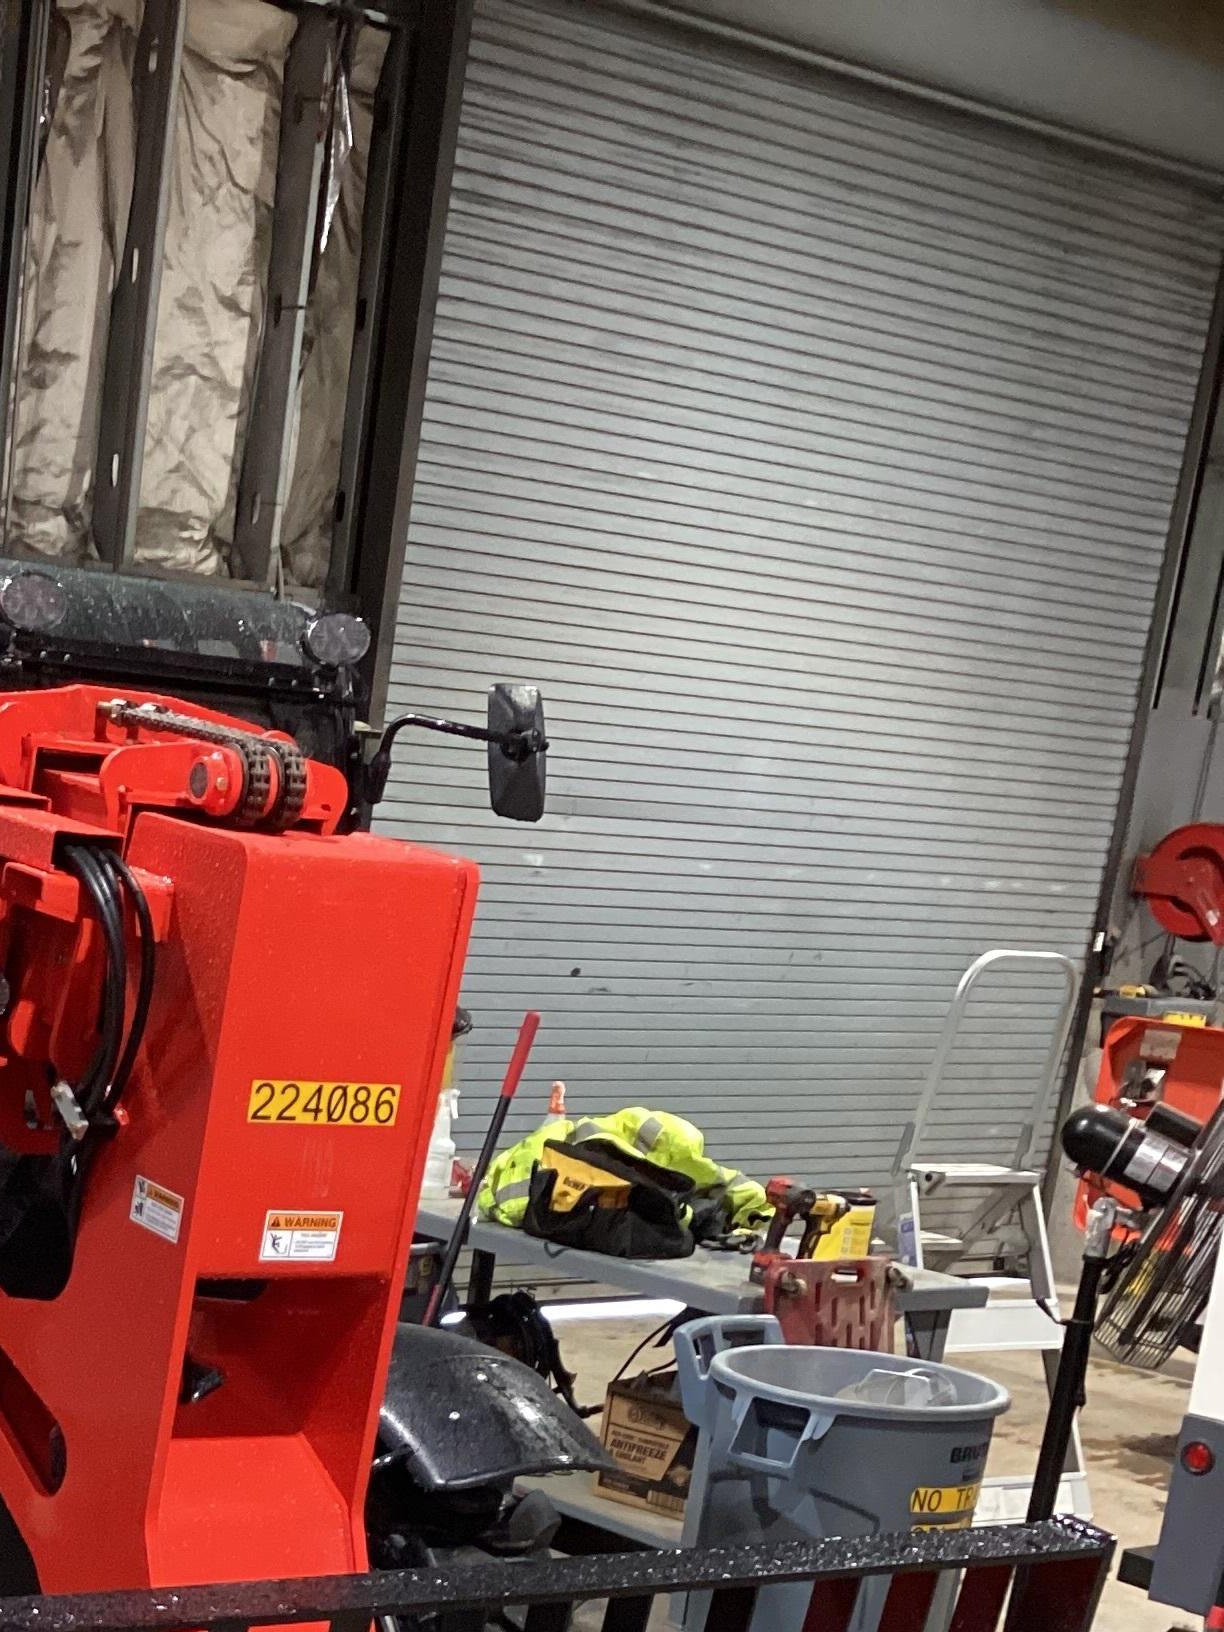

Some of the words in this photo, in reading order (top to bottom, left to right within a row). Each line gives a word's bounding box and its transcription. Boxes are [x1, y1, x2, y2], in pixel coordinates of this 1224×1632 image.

[250, 1082, 397, 1124] 224086
[284, 1216, 337, 1229] WARNING
[609, 1438, 667, 1461] ANTIFREEZE
[912, 1489, 942, 1512] NO
